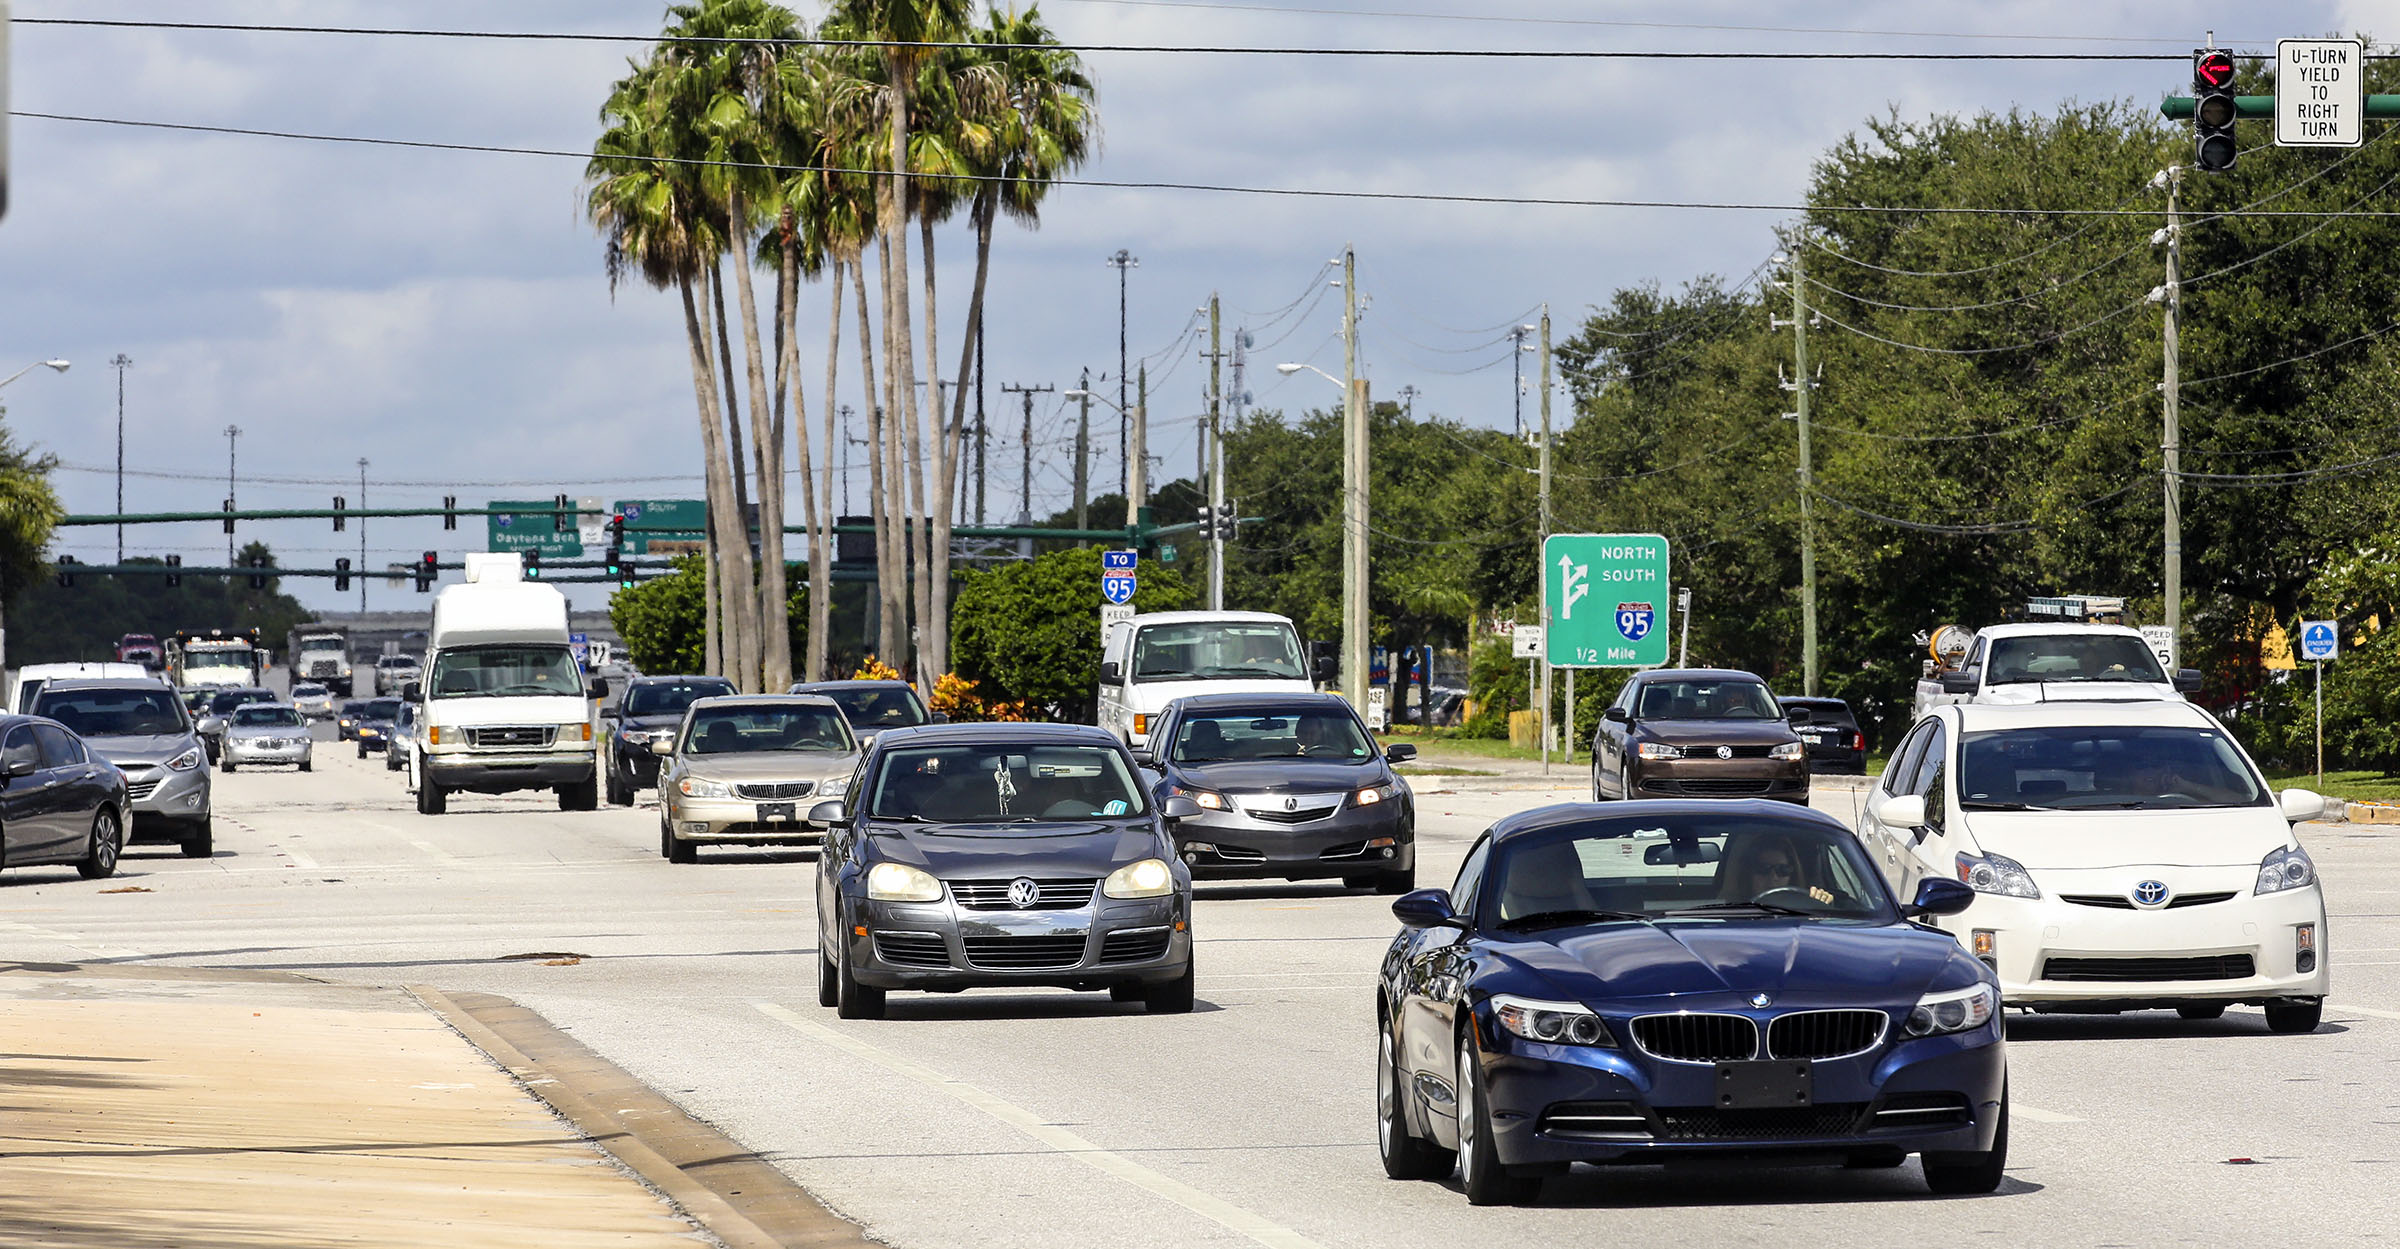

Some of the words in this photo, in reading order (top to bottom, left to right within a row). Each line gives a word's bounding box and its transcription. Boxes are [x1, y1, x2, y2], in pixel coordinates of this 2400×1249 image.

[2292, 49, 2346, 64] U-TURN
[2300, 67, 2339, 82] YIELD
[2311, 85, 2328, 100] TO
[2298, 104, 2339, 118] RIGHT
[2301, 122, 2337, 136] TURN
[496, 533, 546, 546] Daytona
[1111, 554, 1128, 565] TO
[1601, 547, 1656, 560] NORTH
[1602, 569, 1655, 581] SOUTH
[1107, 579, 1130, 599] 95
[1621, 612, 1648, 636] 95
[1576, 647, 1598, 662] 1/2
[1607, 647, 1636, 660] Mile
[2158, 649, 2170, 665] 5
